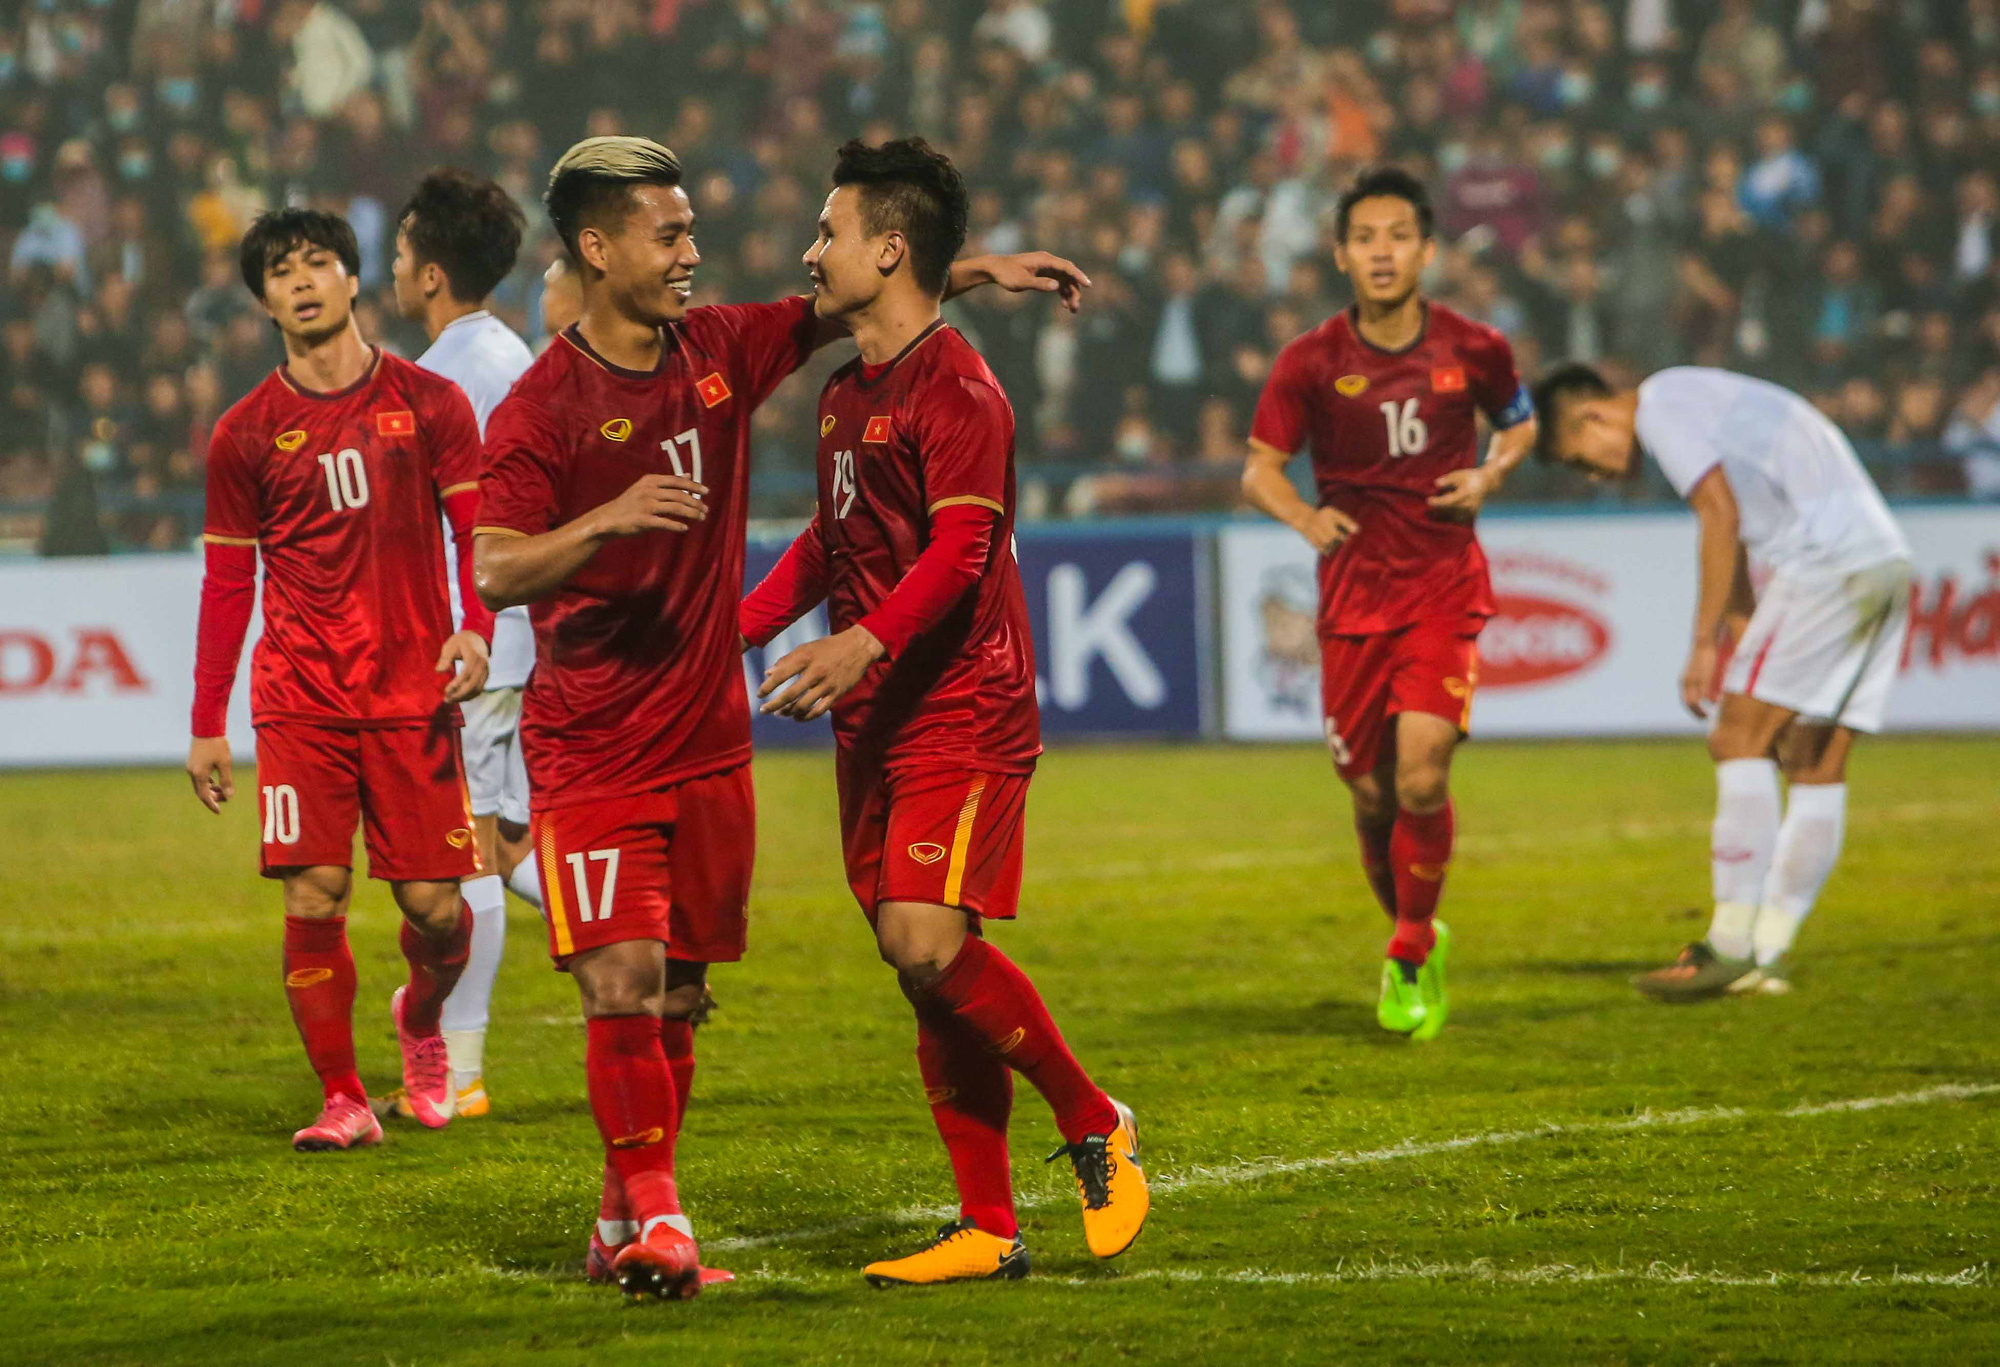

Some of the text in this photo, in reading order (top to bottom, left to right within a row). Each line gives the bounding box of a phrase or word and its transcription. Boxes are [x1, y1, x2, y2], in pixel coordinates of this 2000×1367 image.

[1380, 397, 1428, 458] 16
[317, 448, 370, 512] 10
[660, 427, 702, 500] 17
[832, 449, 856, 520] 19
[262, 784, 301, 845] 10
[565, 848, 620, 923] 17
